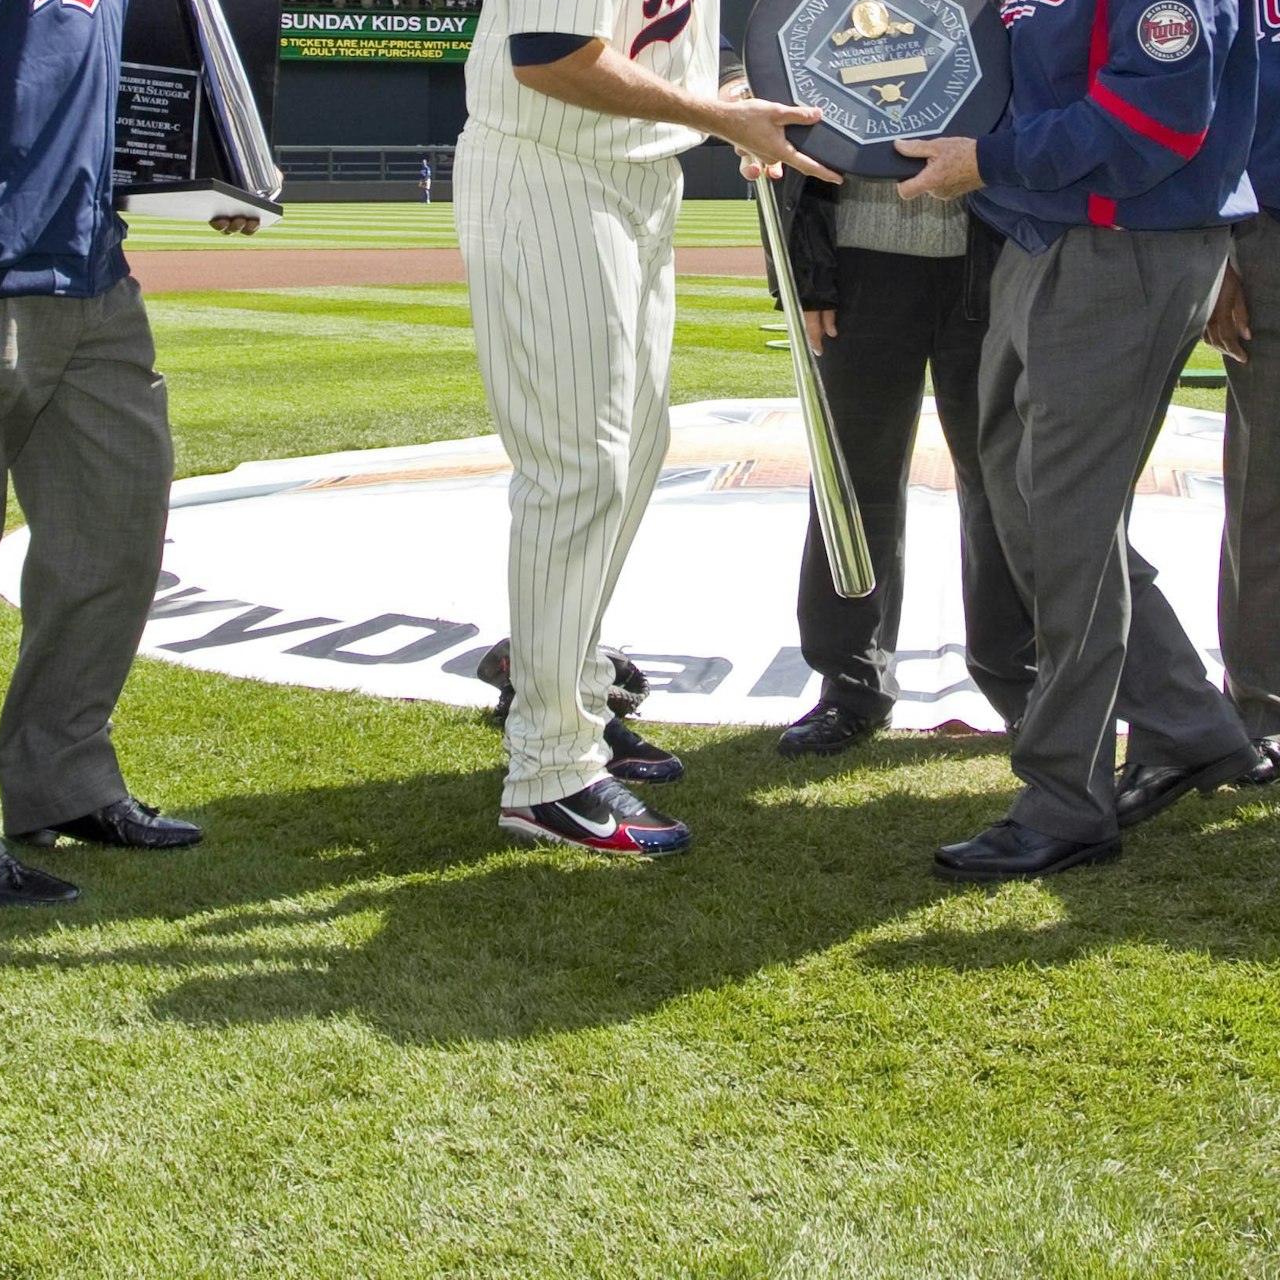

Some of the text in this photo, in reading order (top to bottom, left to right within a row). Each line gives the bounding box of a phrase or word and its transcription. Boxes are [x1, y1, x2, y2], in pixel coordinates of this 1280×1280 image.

[1145, 4, 1193, 20] MINNESOTA
[281, 14, 468, 33] SUNDAY KIDS DAY
[1143, 19, 1193, 43] Twins
[289, 38, 335, 48] TICKETS
[336, 39, 359, 49] ARE
[360, 40, 421, 50] HALF-PRICE
[422, 41, 450, 50] WITH
[452, 41, 473, 50] EAC
[863, 37, 888, 46] MOST
[302, 47, 444, 58] ADULT TICKET PURCHASED
[834, 40, 921, 59] VALUABLE PLAYER
[828, 47, 936, 69] AMERICAN LEAGUE
[119, 83, 145, 95] ILVER
[793, 46, 971, 135] MEMORIAL BASEBALL AWARD
[131, 93, 169, 106] AWARD
[116, 117, 181, 131] JOE MAUER-C
[130, 128, 165, 137] Minnesota
